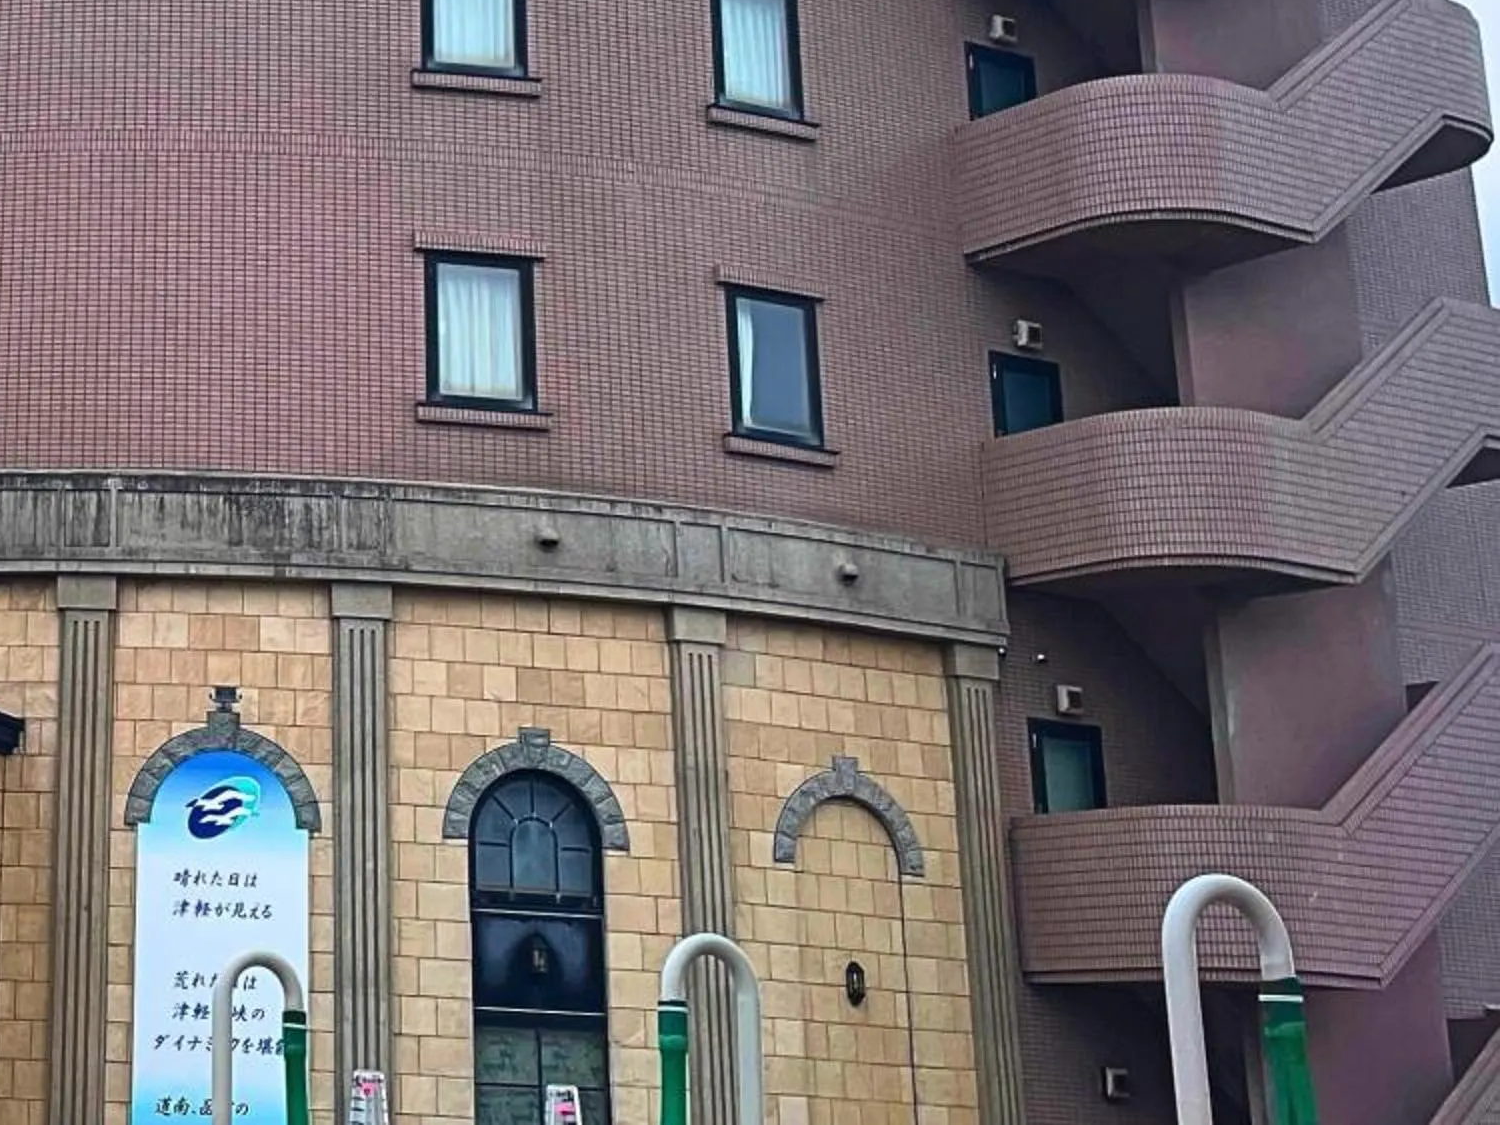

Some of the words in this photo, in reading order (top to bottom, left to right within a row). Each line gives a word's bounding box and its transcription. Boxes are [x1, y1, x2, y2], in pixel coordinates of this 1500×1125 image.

[173, 868, 257, 888] 晴れた日は
[172, 899, 272, 920] 津軽が見える
[173, 970, 257, 990] 荒れは
[171, 1001, 265, 1022] 津軽峡の
